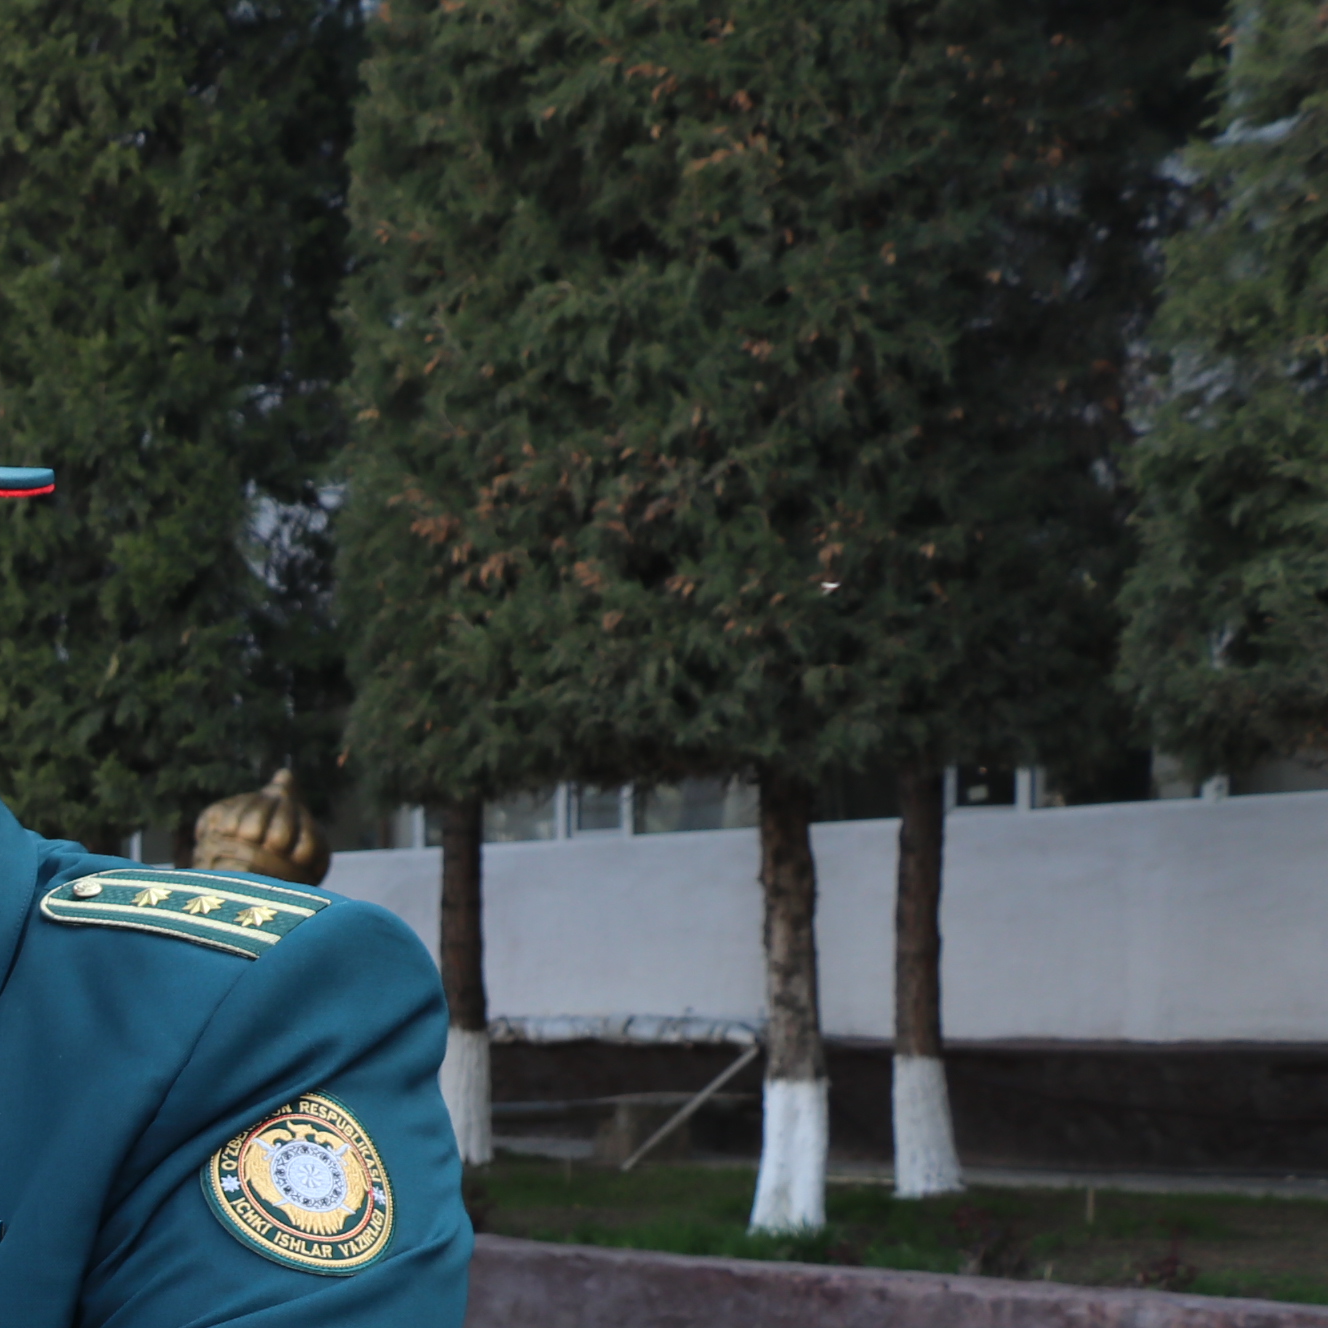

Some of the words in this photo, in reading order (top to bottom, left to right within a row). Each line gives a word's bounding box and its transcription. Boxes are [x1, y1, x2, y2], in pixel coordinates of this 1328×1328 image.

[299, 1100, 382, 1183] RESPUBLIKASI
[230, 1196, 272, 1235] ICHKI
[274, 1231, 333, 1258] ISHLAR
[338, 1210, 384, 1257] VAZIRLIGI
